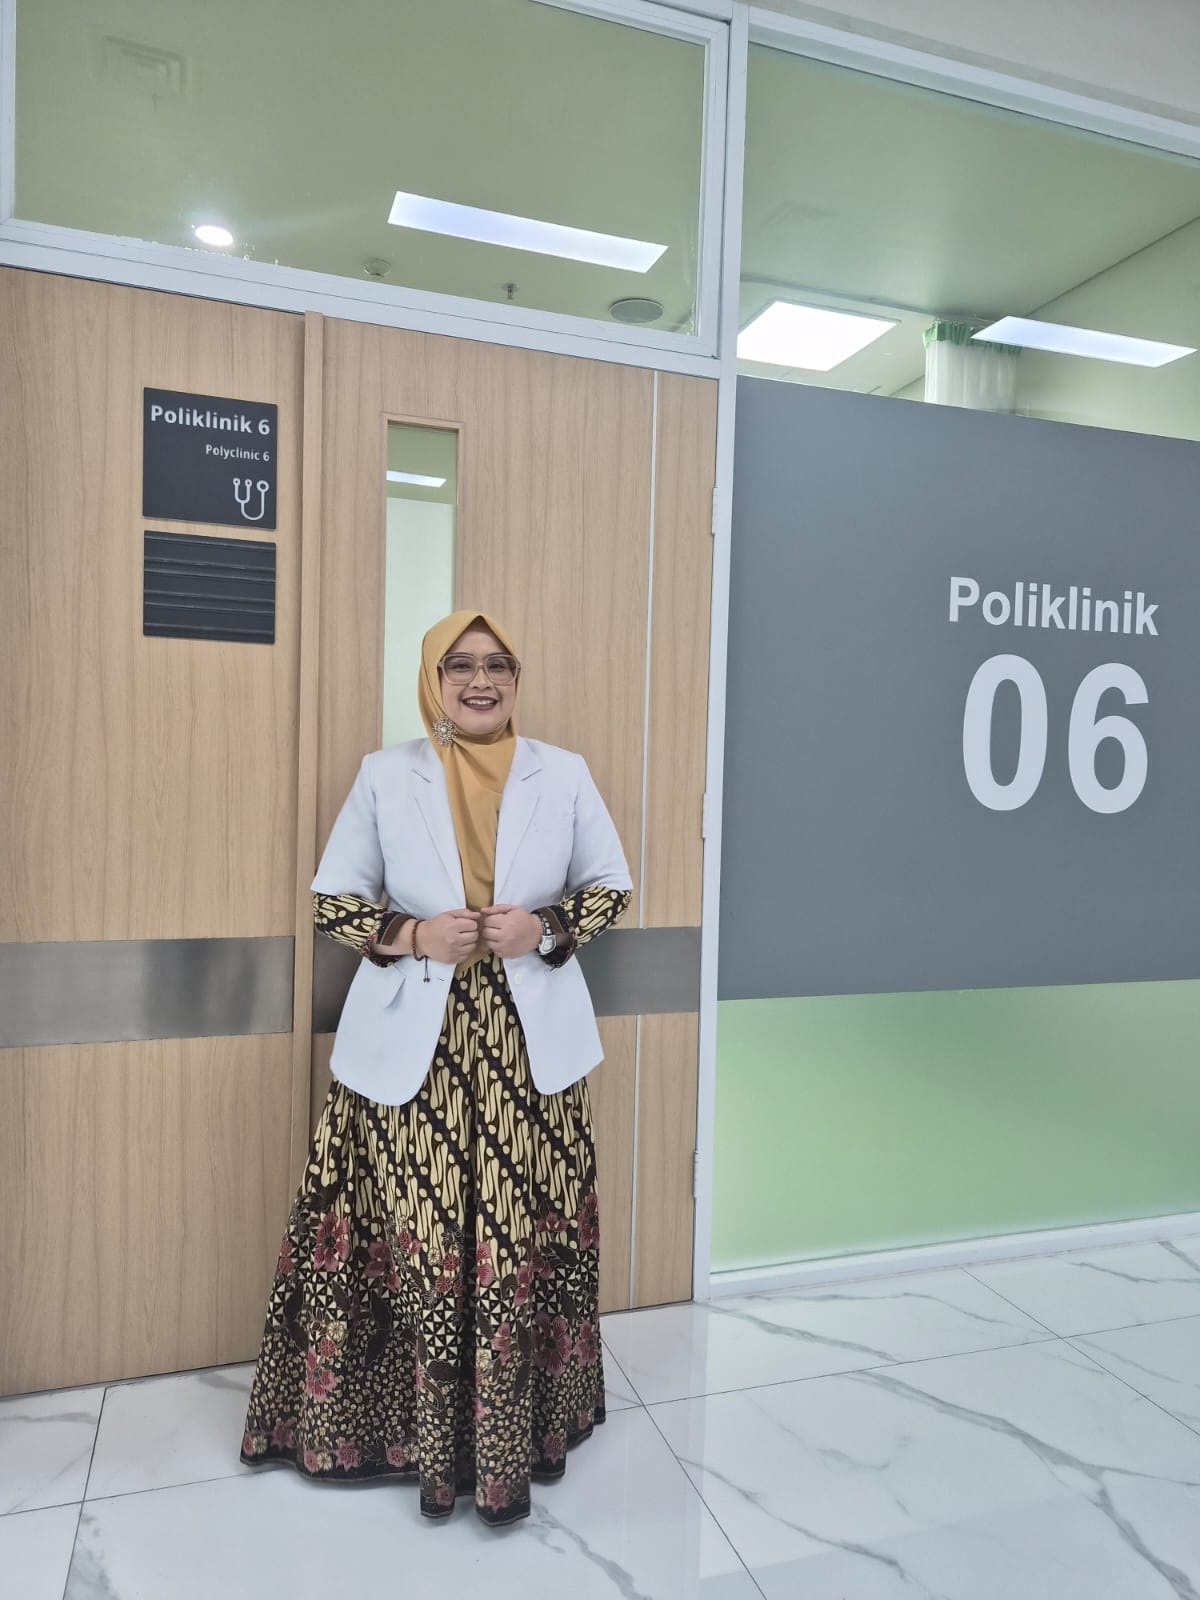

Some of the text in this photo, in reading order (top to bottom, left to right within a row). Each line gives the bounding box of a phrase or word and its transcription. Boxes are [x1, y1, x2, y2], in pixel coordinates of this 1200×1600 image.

[150, 404, 270, 435] Poliklinik 6
[205, 444, 270, 462] Polyclinic 6
[949, 576, 1159, 636] Poliklinik
[962, 653, 1150, 815] 06
